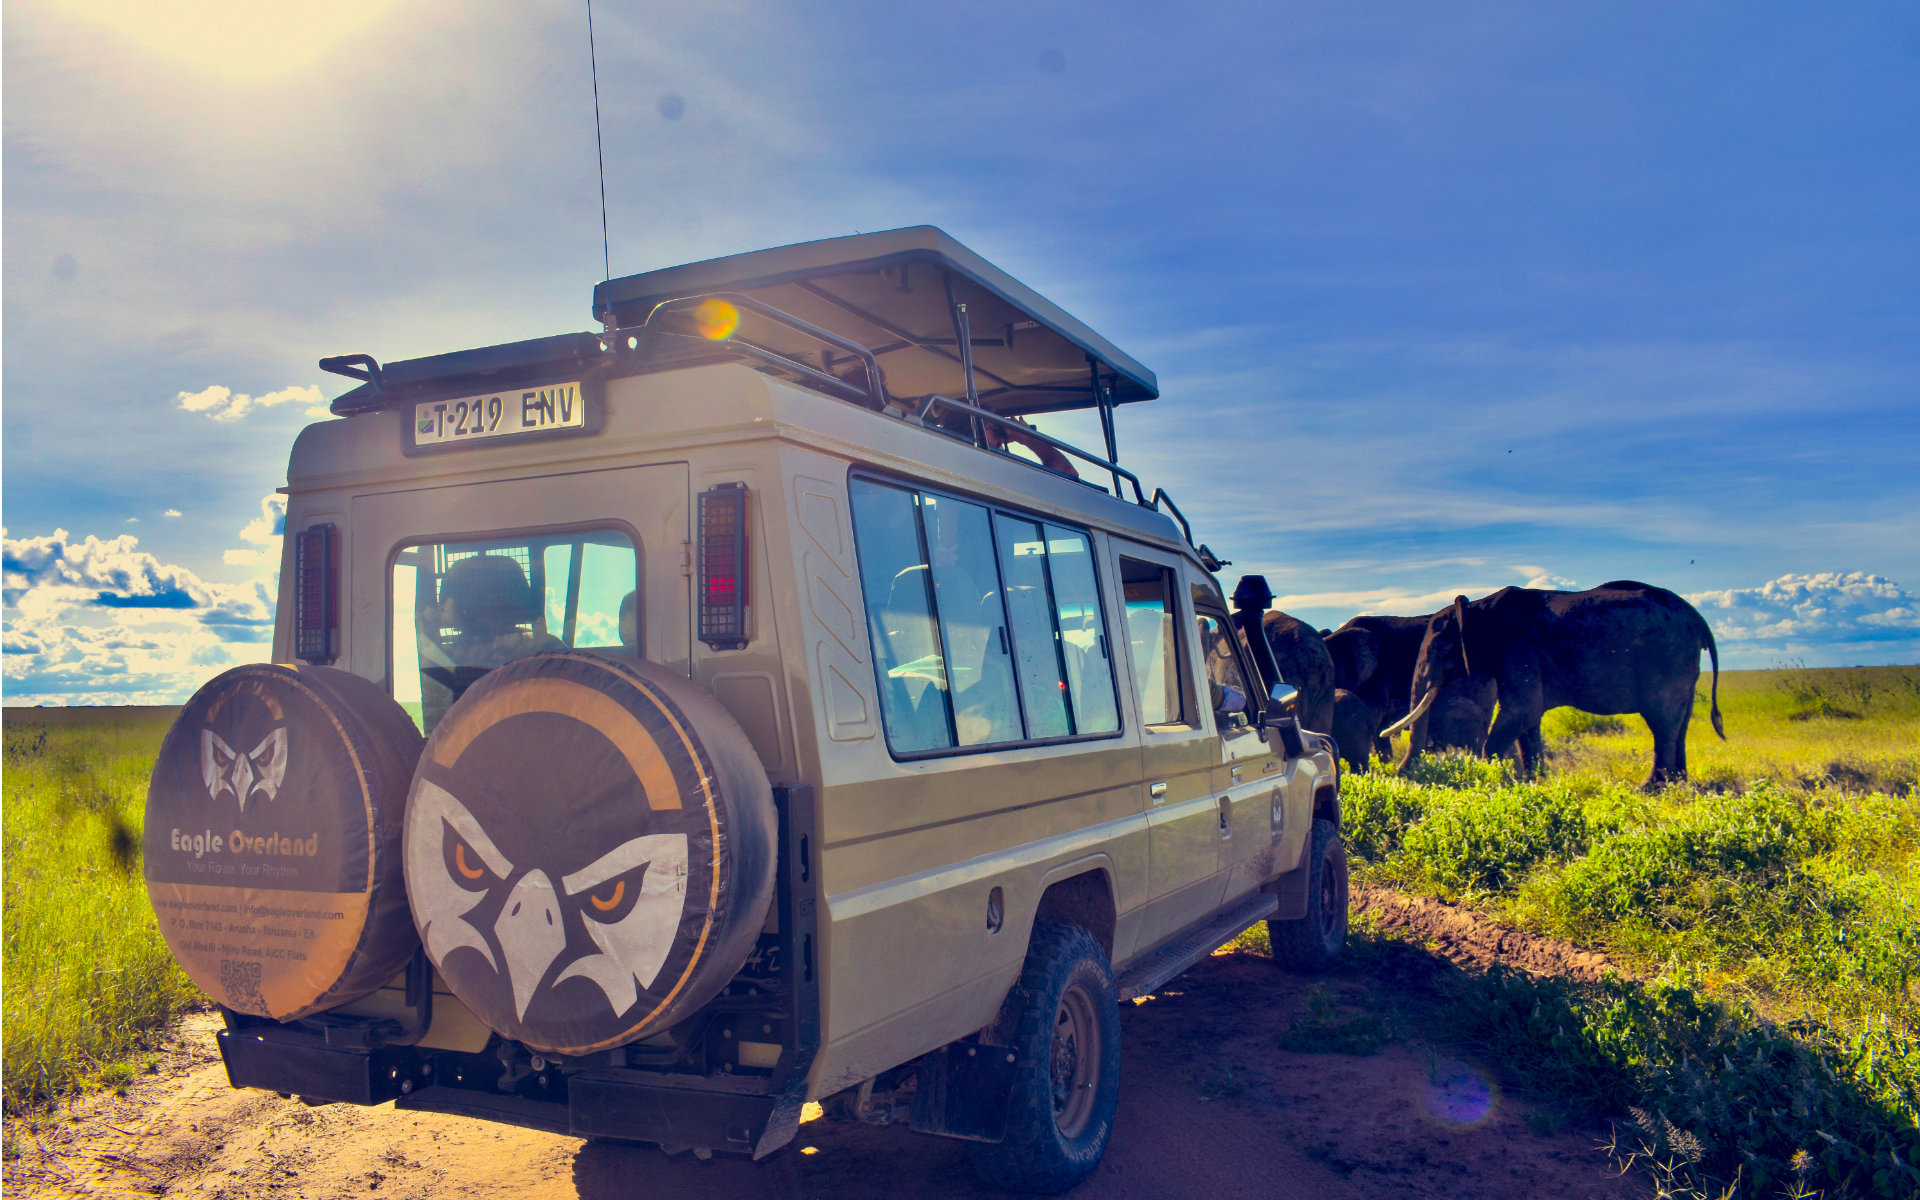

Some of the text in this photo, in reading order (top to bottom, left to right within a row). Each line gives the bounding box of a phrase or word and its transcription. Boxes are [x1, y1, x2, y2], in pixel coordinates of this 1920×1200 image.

[522, 386, 575, 428] ENV
[170, 828, 319, 859] Eagle Overland
[187, 860, 207, 873] Your
[239, 862, 261, 876] Your
[262, 863, 298, 879] Rhythm
[244, 904, 345, 919] info@eagleoverland.com
[189, 919, 204, 930] Box
[228, 923, 256, 934] Arusha
[263, 926, 297, 938] Tanzania
[304, 928, 315, 939] EA
[179, 940, 192, 951] Old
[265, 948, 285, 959] AICC
[287, 950, 308, 961] Flats
